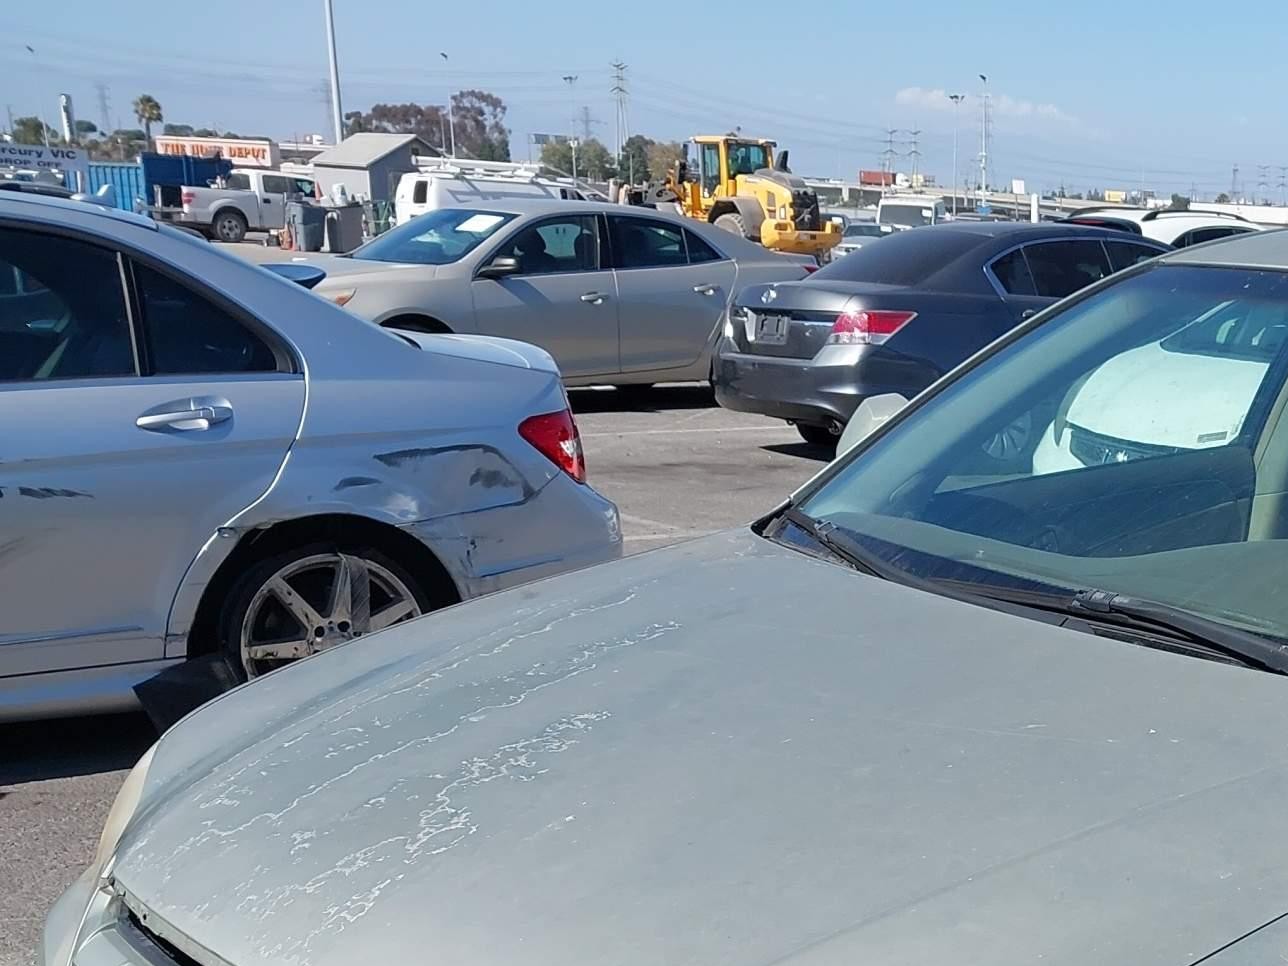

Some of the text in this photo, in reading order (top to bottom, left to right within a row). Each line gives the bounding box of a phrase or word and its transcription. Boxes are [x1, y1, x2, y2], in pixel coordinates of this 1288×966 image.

[50, 148, 77, 160] VIC
[229, 146, 267, 160] DEPOT
[36, 160, 62, 168] OFF
